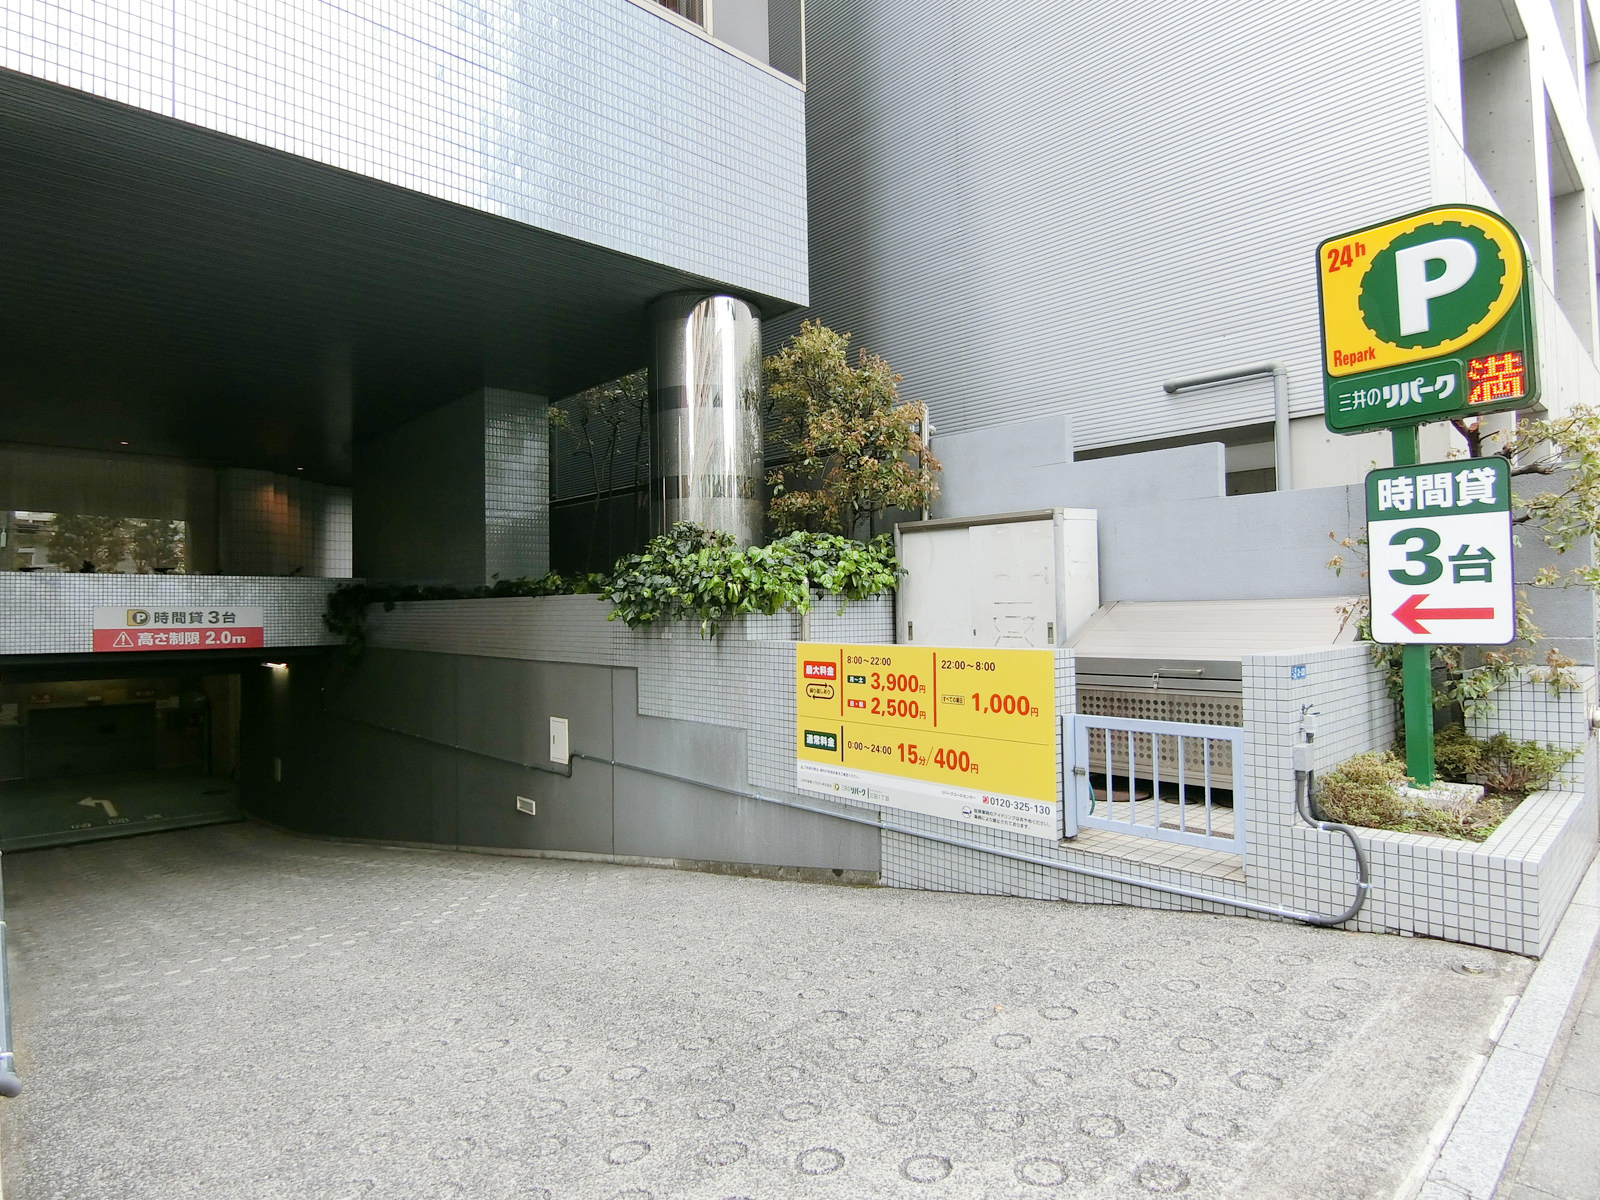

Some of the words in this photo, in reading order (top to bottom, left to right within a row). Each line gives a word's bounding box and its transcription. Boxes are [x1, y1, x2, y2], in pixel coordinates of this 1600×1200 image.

[1327, 242, 1366, 273] 24h
[1395, 238, 1477, 337] P
[1333, 346, 1376, 367] Repark
[1468, 352, 1524, 404] 満
[1338, 373, 1456, 412] 三井のリパーク
[1377, 466, 1497, 512] 時間貸
[1388, 527, 1496, 586] 3台
[153, 611, 204, 625] 時間貸
[208, 611, 237, 624] 3台
[137, 631, 200, 647] 高さ制限
[205, 631, 247, 645] 2.0m
[805, 664, 835, 677] 最大料金
[870, 672, 926, 694] 3,900円
[871, 697, 926, 720] 2,500円
[971, 692, 1039, 717] 1,000円
[805, 733, 836, 749] 通常料金
[990, 796, 1051, 816] 0120-325-130
